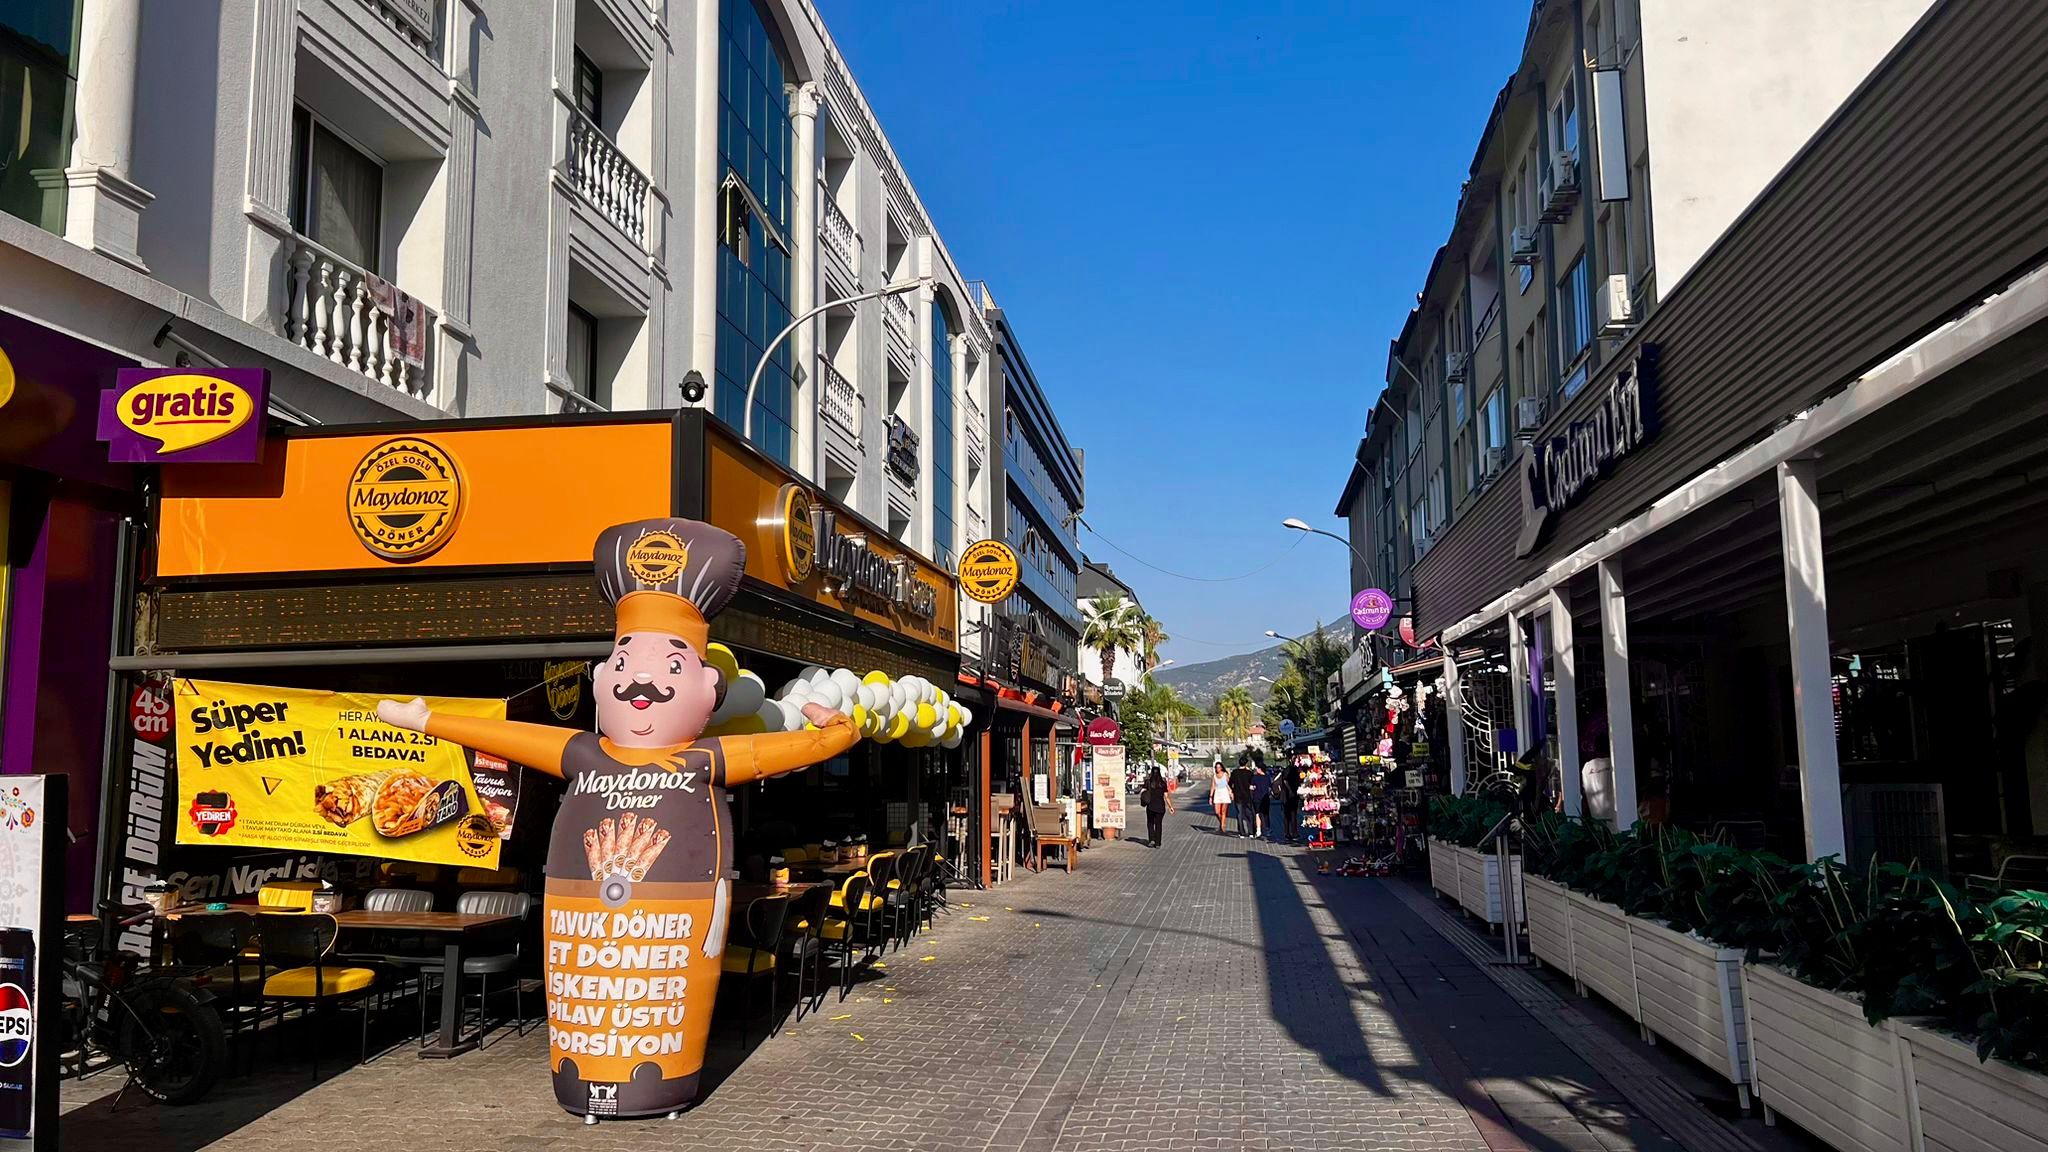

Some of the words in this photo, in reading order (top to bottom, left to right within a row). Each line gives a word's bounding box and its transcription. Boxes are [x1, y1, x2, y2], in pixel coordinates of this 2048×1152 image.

[131, 382, 235, 426] gratis
[376, 458, 400, 473] ÖZEL
[402, 456, 432, 471] SOSLU
[353, 487, 449, 511] Maydonoz
[377, 526, 424, 541] DÖNER
[629, 549, 683, 565] Maydonoz
[640, 571, 667, 579] DÖNER
[962, 566, 1013, 579] Maydonoz
[975, 587, 1000, 595] DÖNER
[136, 687, 170, 715] 45
[134, 715, 169, 732] cm
[190, 699, 289, 734] Süper
[338, 711, 363, 722] HER
[364, 711, 387, 723] AY
[337, 727, 344, 739] 1
[348, 728, 406, 744] ALANA
[190, 729, 307, 768] Yedim!
[352, 745, 425, 763] BEDAVA!
[473, 773, 505, 786] Tavuk
[574, 767, 697, 798] Maydonoz
[126, 739, 166, 865] DÜRÜM
[606, 791, 663, 810] Döner
[167, 871, 221, 901] Sen
[551, 909, 609, 939] TAVUK
[612, 909, 693, 939] DÖNER
[549, 940, 573, 966] ET
[577, 940, 690, 970] DÖNER
[548, 965, 688, 1001] İSKENDER
[549, 997, 606, 1027] PİLAV
[611, 1001, 685, 1029] ÜSTÜ
[0, 1016, 29, 1036] EPSI
[550, 1025, 684, 1058] PORSİYON
